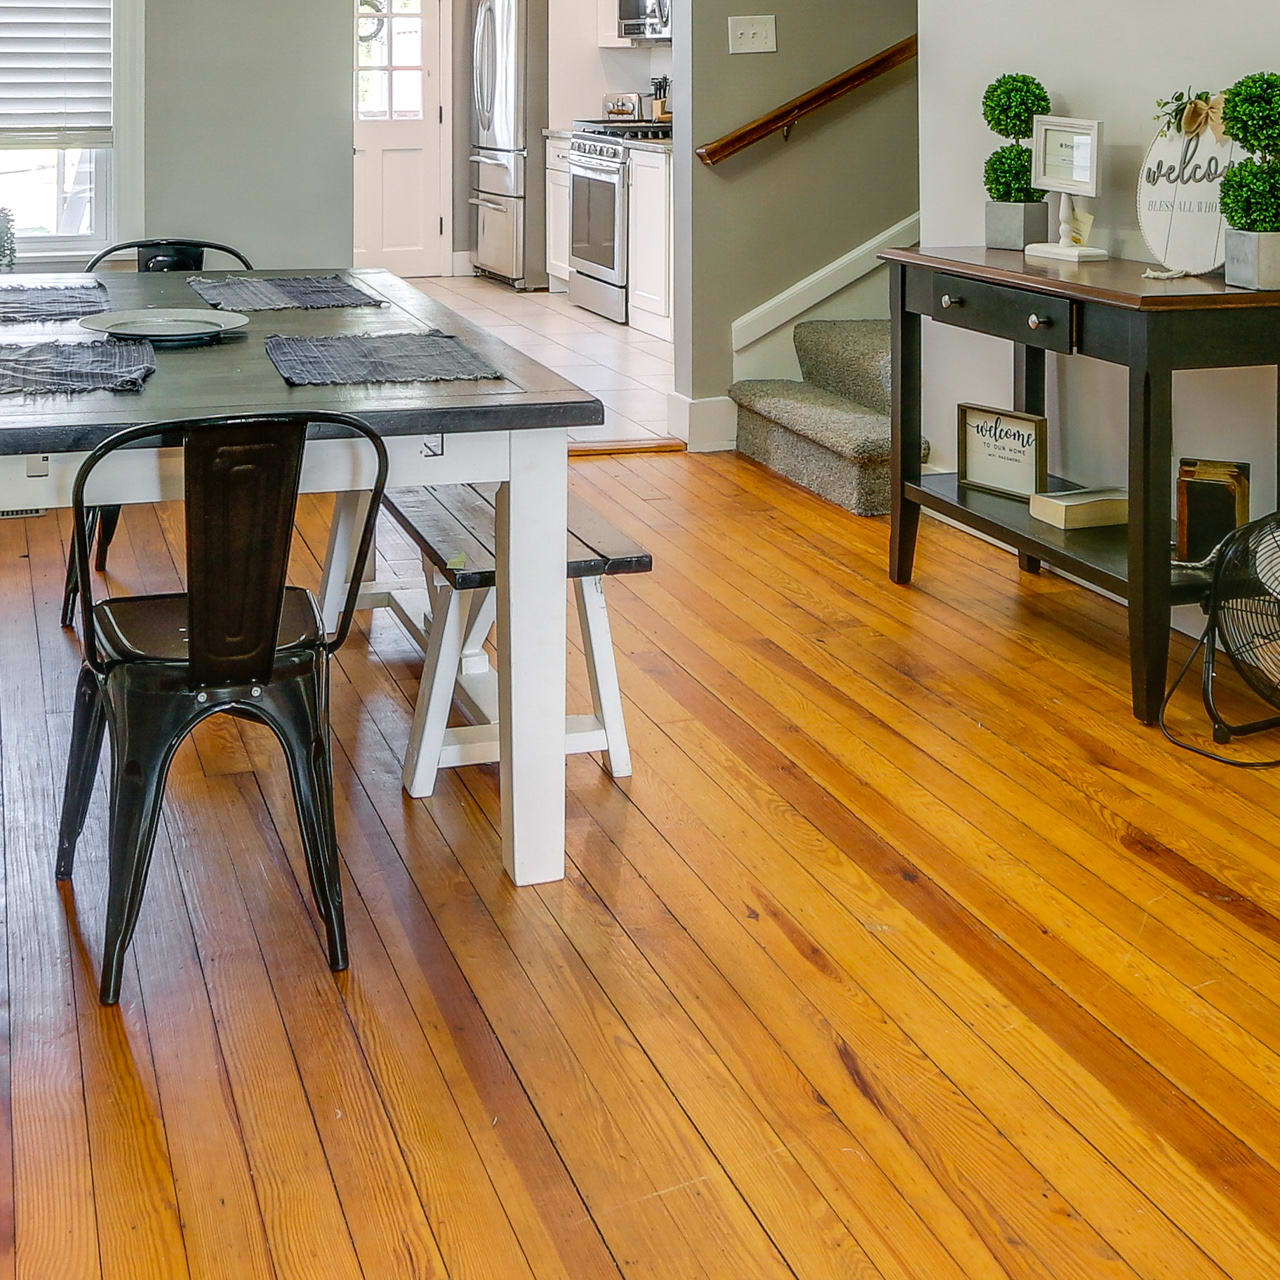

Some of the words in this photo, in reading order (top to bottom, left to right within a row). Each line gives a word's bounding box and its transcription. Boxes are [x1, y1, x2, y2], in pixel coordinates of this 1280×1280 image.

[1147, 200, 1174, 212] BLESS
[1177, 200, 1194, 213] ALL
[1197, 201, 1218, 213] WHO
[967, 417, 1036, 448] welcome
[1009, 448, 1026, 456] HOME
